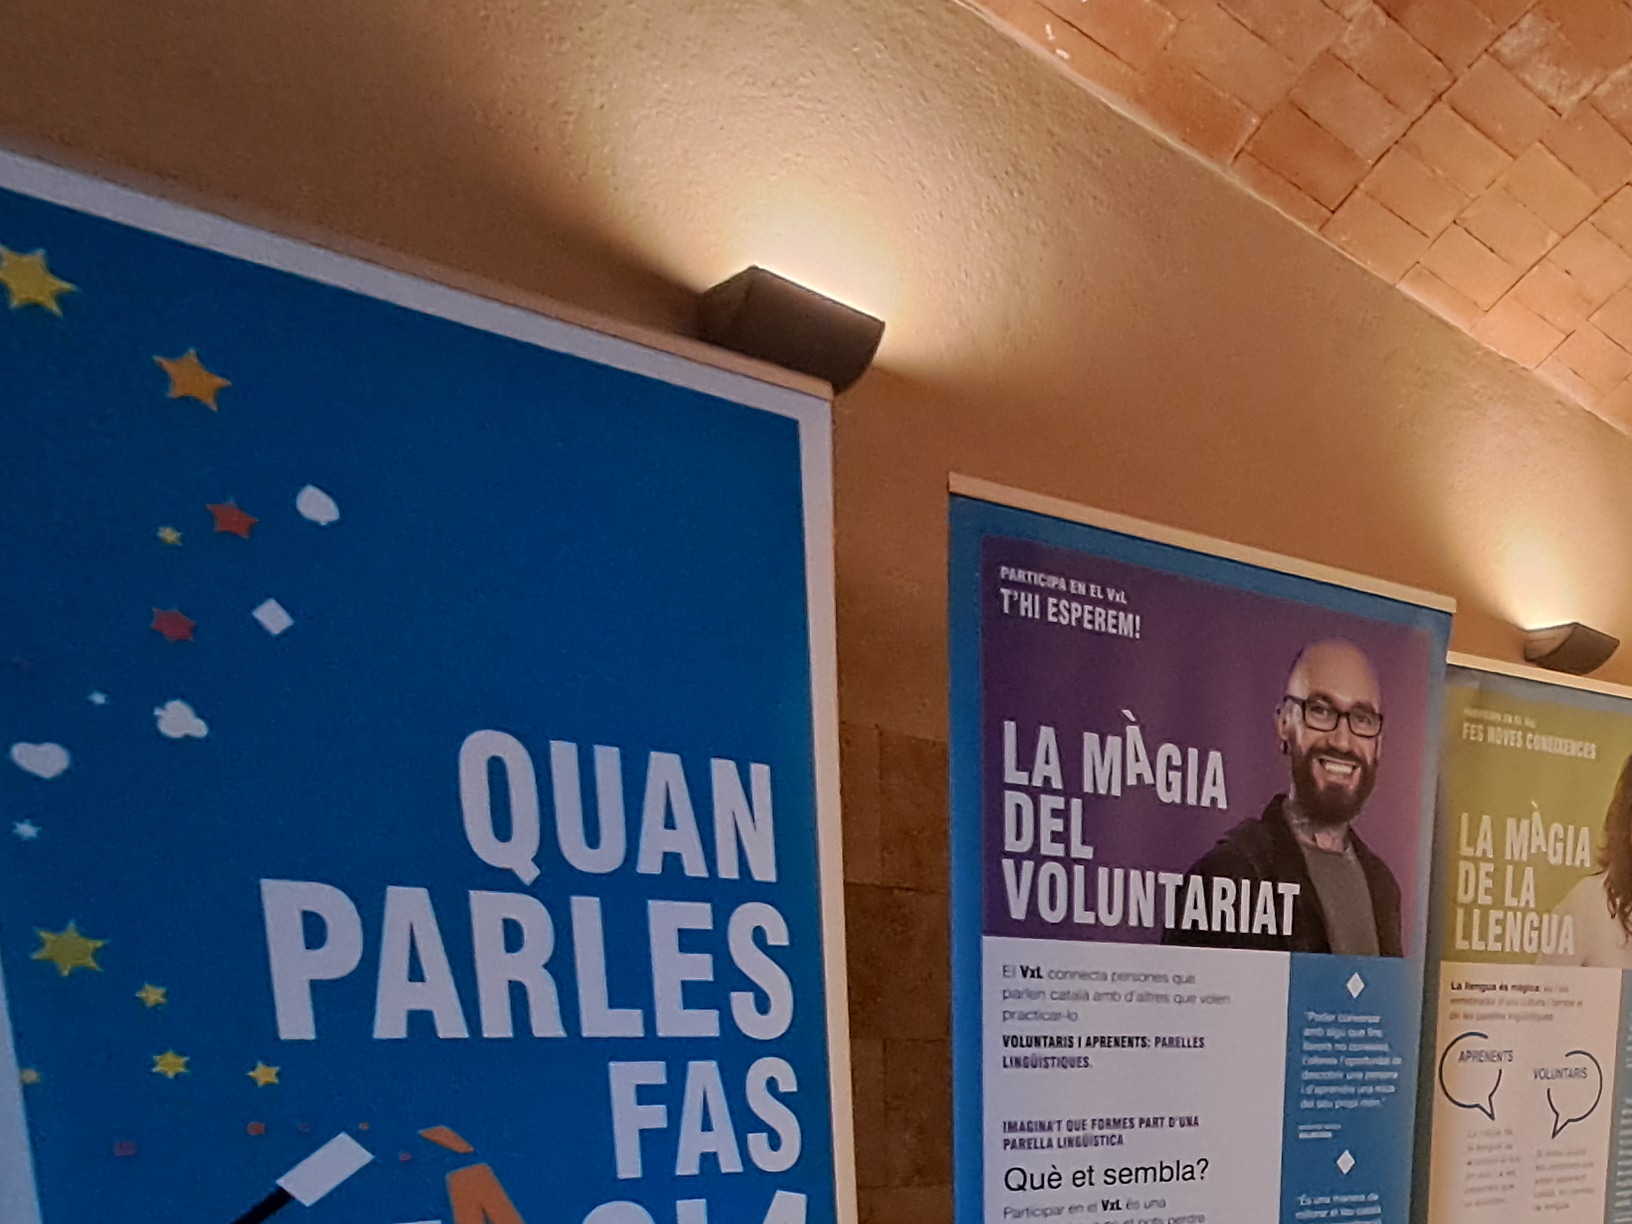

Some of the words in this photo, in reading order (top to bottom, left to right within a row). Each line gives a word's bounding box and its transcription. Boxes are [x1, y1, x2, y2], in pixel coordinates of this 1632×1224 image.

[1000, 566, 1066, 591] PARTICIPA
[1070, 580, 1086, 595] EN
[1090, 584, 1104, 598] EL
[1106, 588, 1127, 604] VxL
[1000, 588, 1040, 619] T'HI
[1048, 597, 1140, 639] ESPEREM!
[1462, 721, 1484, 742] FES
[1003, 720, 1063, 790] LA
[1083, 709, 1228, 810] MÀGIA
[458, 729, 777, 886] QUAN
[1004, 790, 1094, 860] DEL
[1460, 812, 1494, 858] LA
[1505, 800, 1591, 867] MÀGIA
[1002, 858, 1300, 936] VOLUNTARIAT
[1458, 860, 1494, 905] DE
[1505, 865, 1535, 908] LA
[1455, 908, 1575, 955] LLENGUA
[260, 878, 794, 1040] PARLES
[1020, 965, 1043, 979] VxL
[1172, 975, 1196, 985] que
[1174, 994, 1196, 1004] que
[1451, 982, 1462, 990] La
[1002, 1035, 1074, 1048] VOLUNTARIS
[1078, 1036, 1081, 1048] I
[1086, 1035, 1150, 1048] APRENENTS:
[1155, 1036, 1205, 1048] PARELLES
[1459, 1050, 1513, 1062] APRENENTS
[1533, 1067, 1587, 1080] VOLUNTARIS
[608, 1057, 801, 1179] FAS
[1003, 1120, 1062, 1133] IMAGINA'T
[1067, 1119, 1087, 1132] QUE
[1092, 1118, 1134, 1130] FORMES
[1139, 1117, 1165, 1128] PART
[1168, 1116, 1199, 1127] D'UNA
[1004, 1138, 1053, 1150] PARELLA
[1004, 1164, 1062, 1191] Què
[1072, 1165, 1095, 1187] et
[1104, 1158, 1209, 1185] sembla?
[1102, 1199, 1122, 1211] VxL
